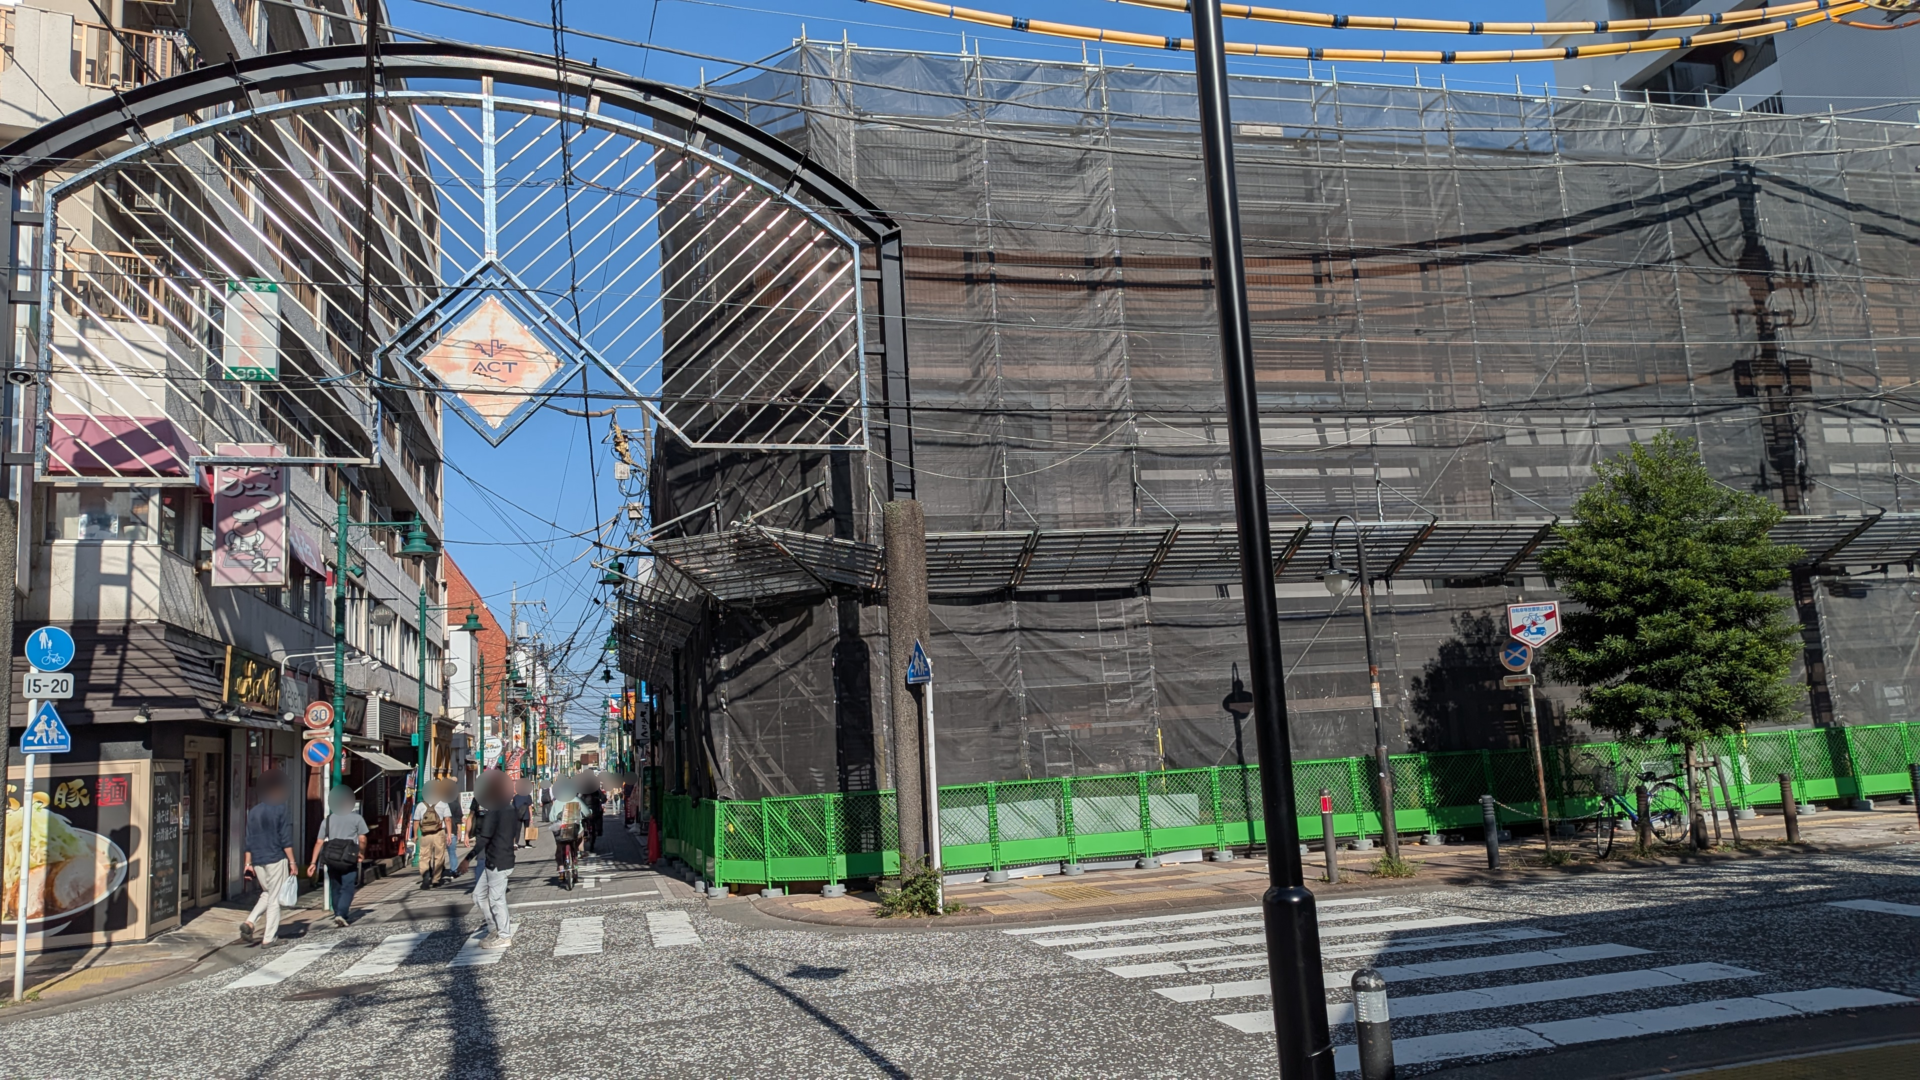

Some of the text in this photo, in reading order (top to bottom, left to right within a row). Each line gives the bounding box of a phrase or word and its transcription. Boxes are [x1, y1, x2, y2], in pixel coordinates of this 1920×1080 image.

[236, 368, 265, 380] 301
[472, 361, 518, 374] ACT
[252, 558, 280, 573] 2F
[27, 679, 69, 693] 15-20
[310, 709, 328, 722] 30
